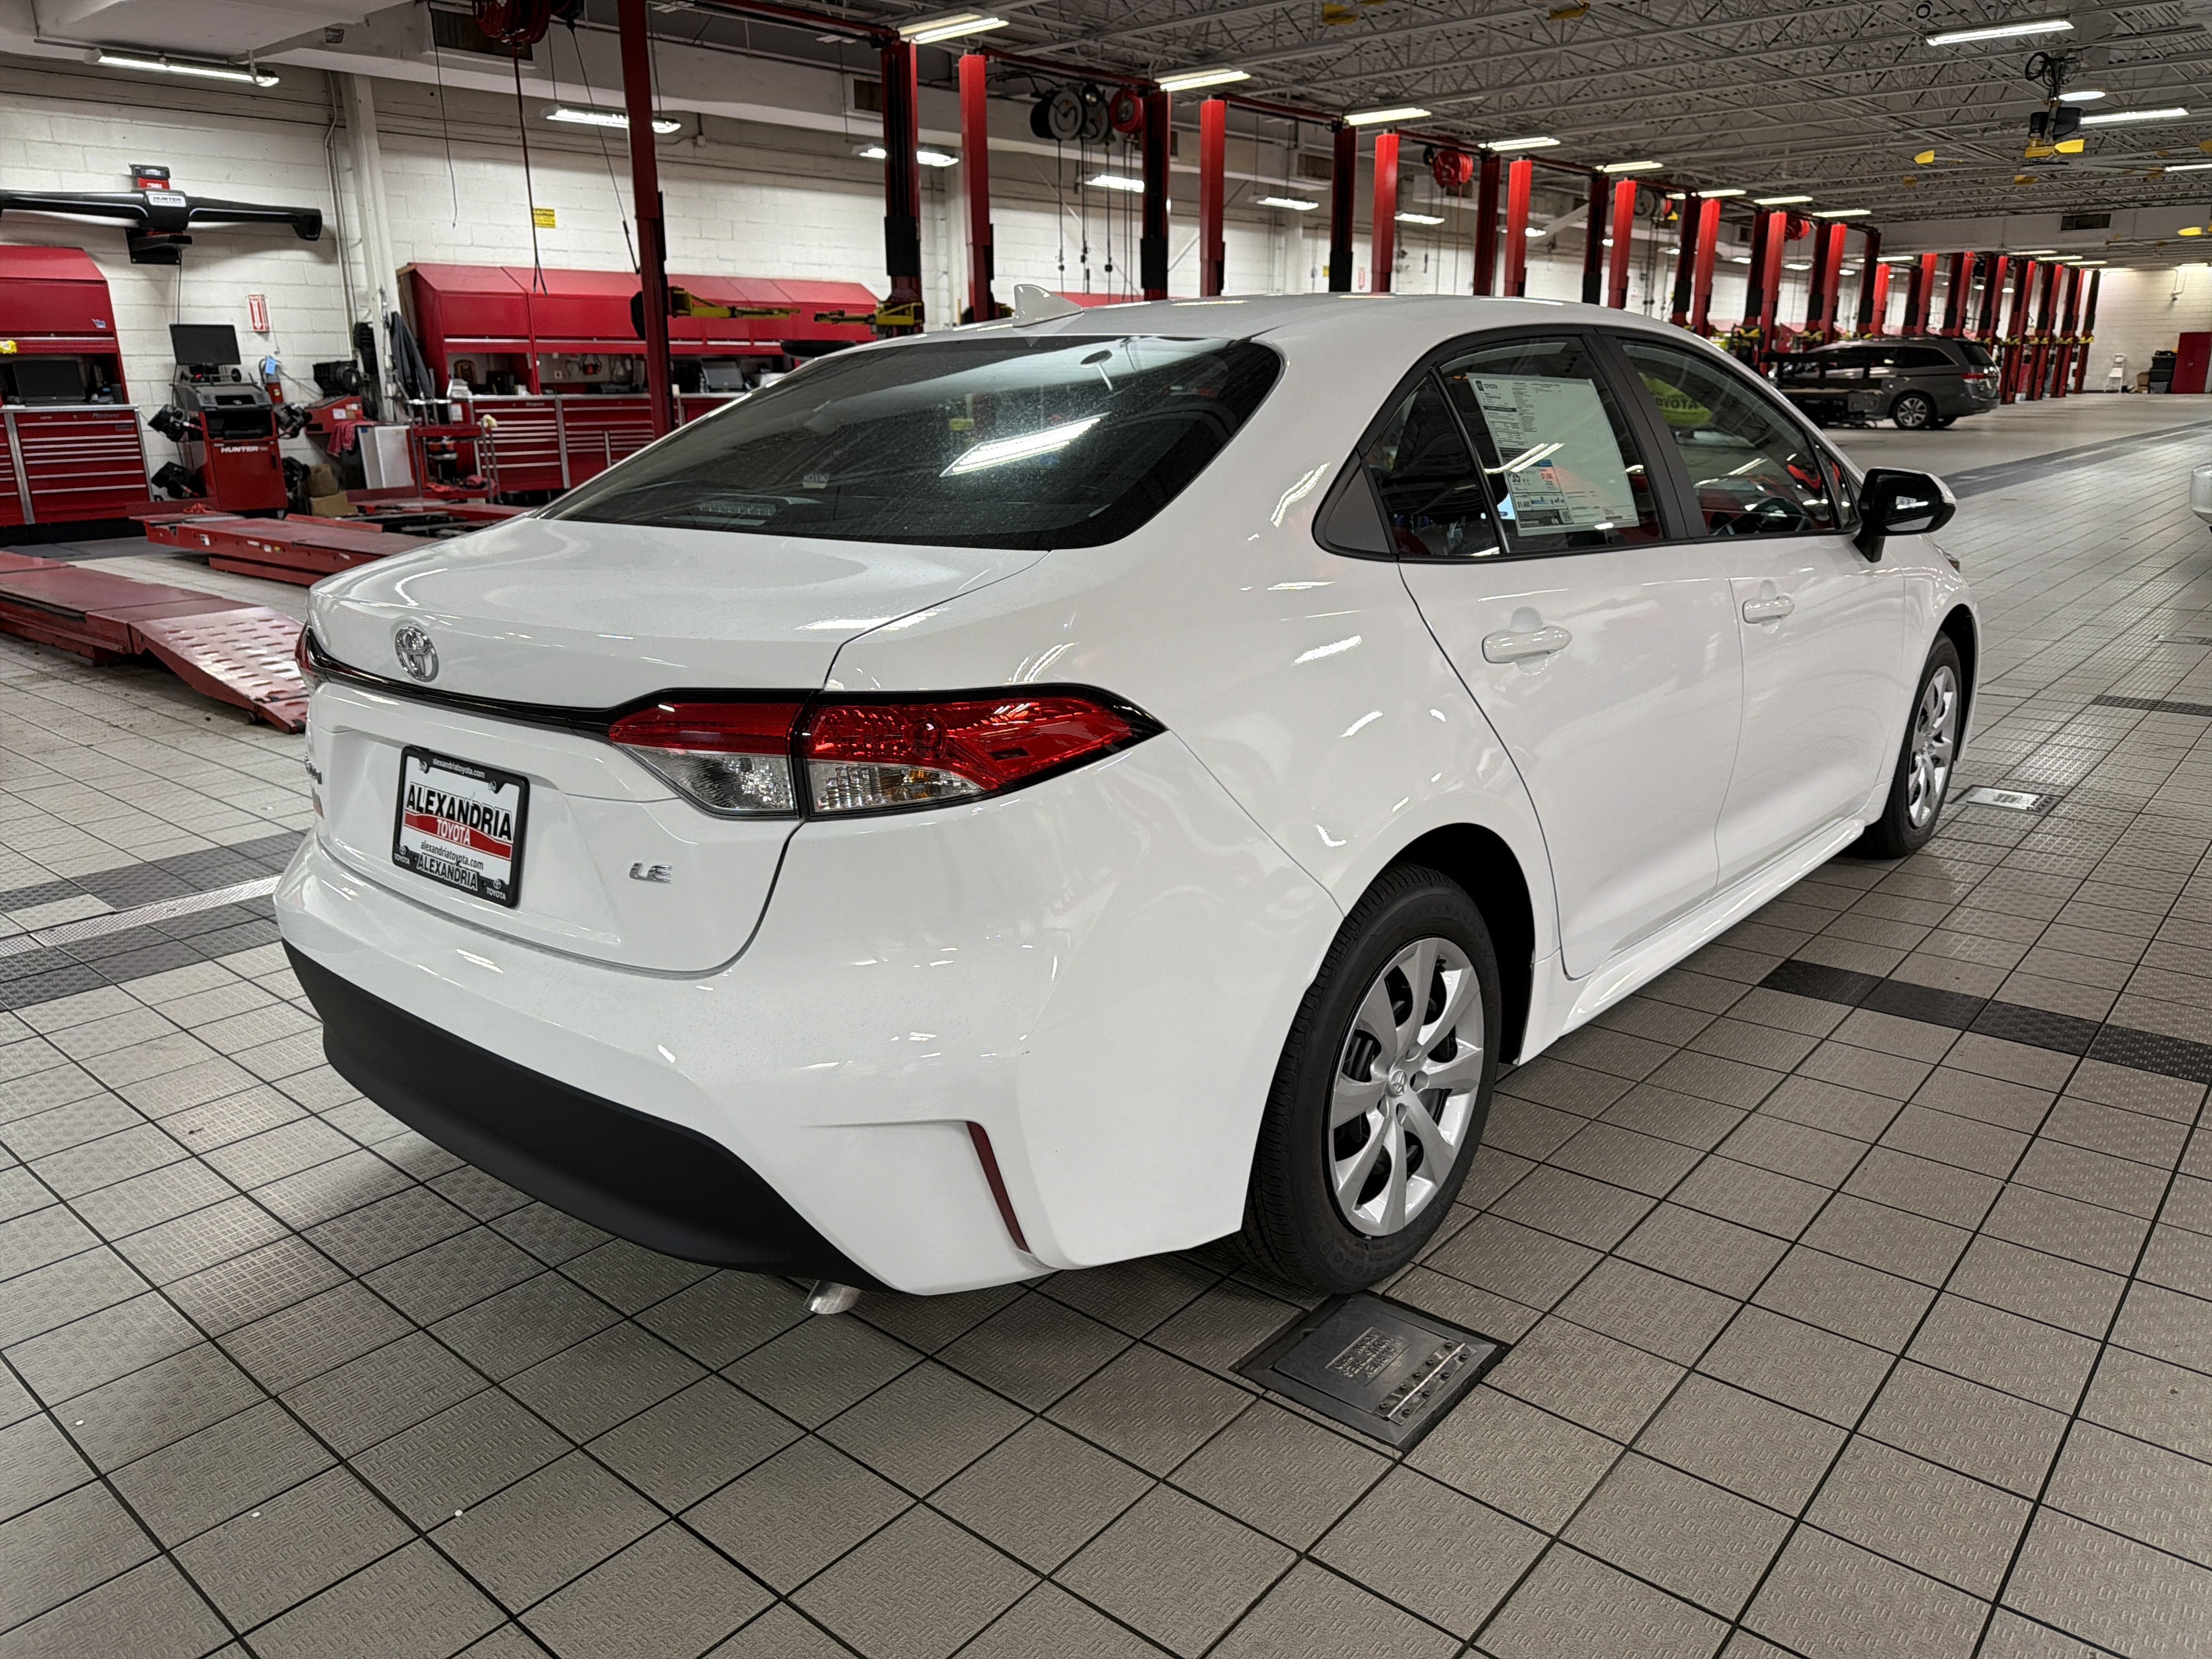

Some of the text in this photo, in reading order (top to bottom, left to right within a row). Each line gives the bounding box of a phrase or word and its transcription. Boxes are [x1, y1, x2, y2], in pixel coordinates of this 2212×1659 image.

[1656, 397, 1698, 409] OYOTA
[432, 758, 486, 778] alexandriatoyota.com
[406, 783, 512, 841] ALEXANDRIA
[437, 819, 471, 845] TOYOTA
[394, 853, 410, 865] TOYOTA
[421, 840, 484, 870] alexandriatoyota.com
[416, 854, 478, 891] ALEXANDRIA
[629, 863, 673, 884] LE
[486, 887, 506, 900] TOYOTA
